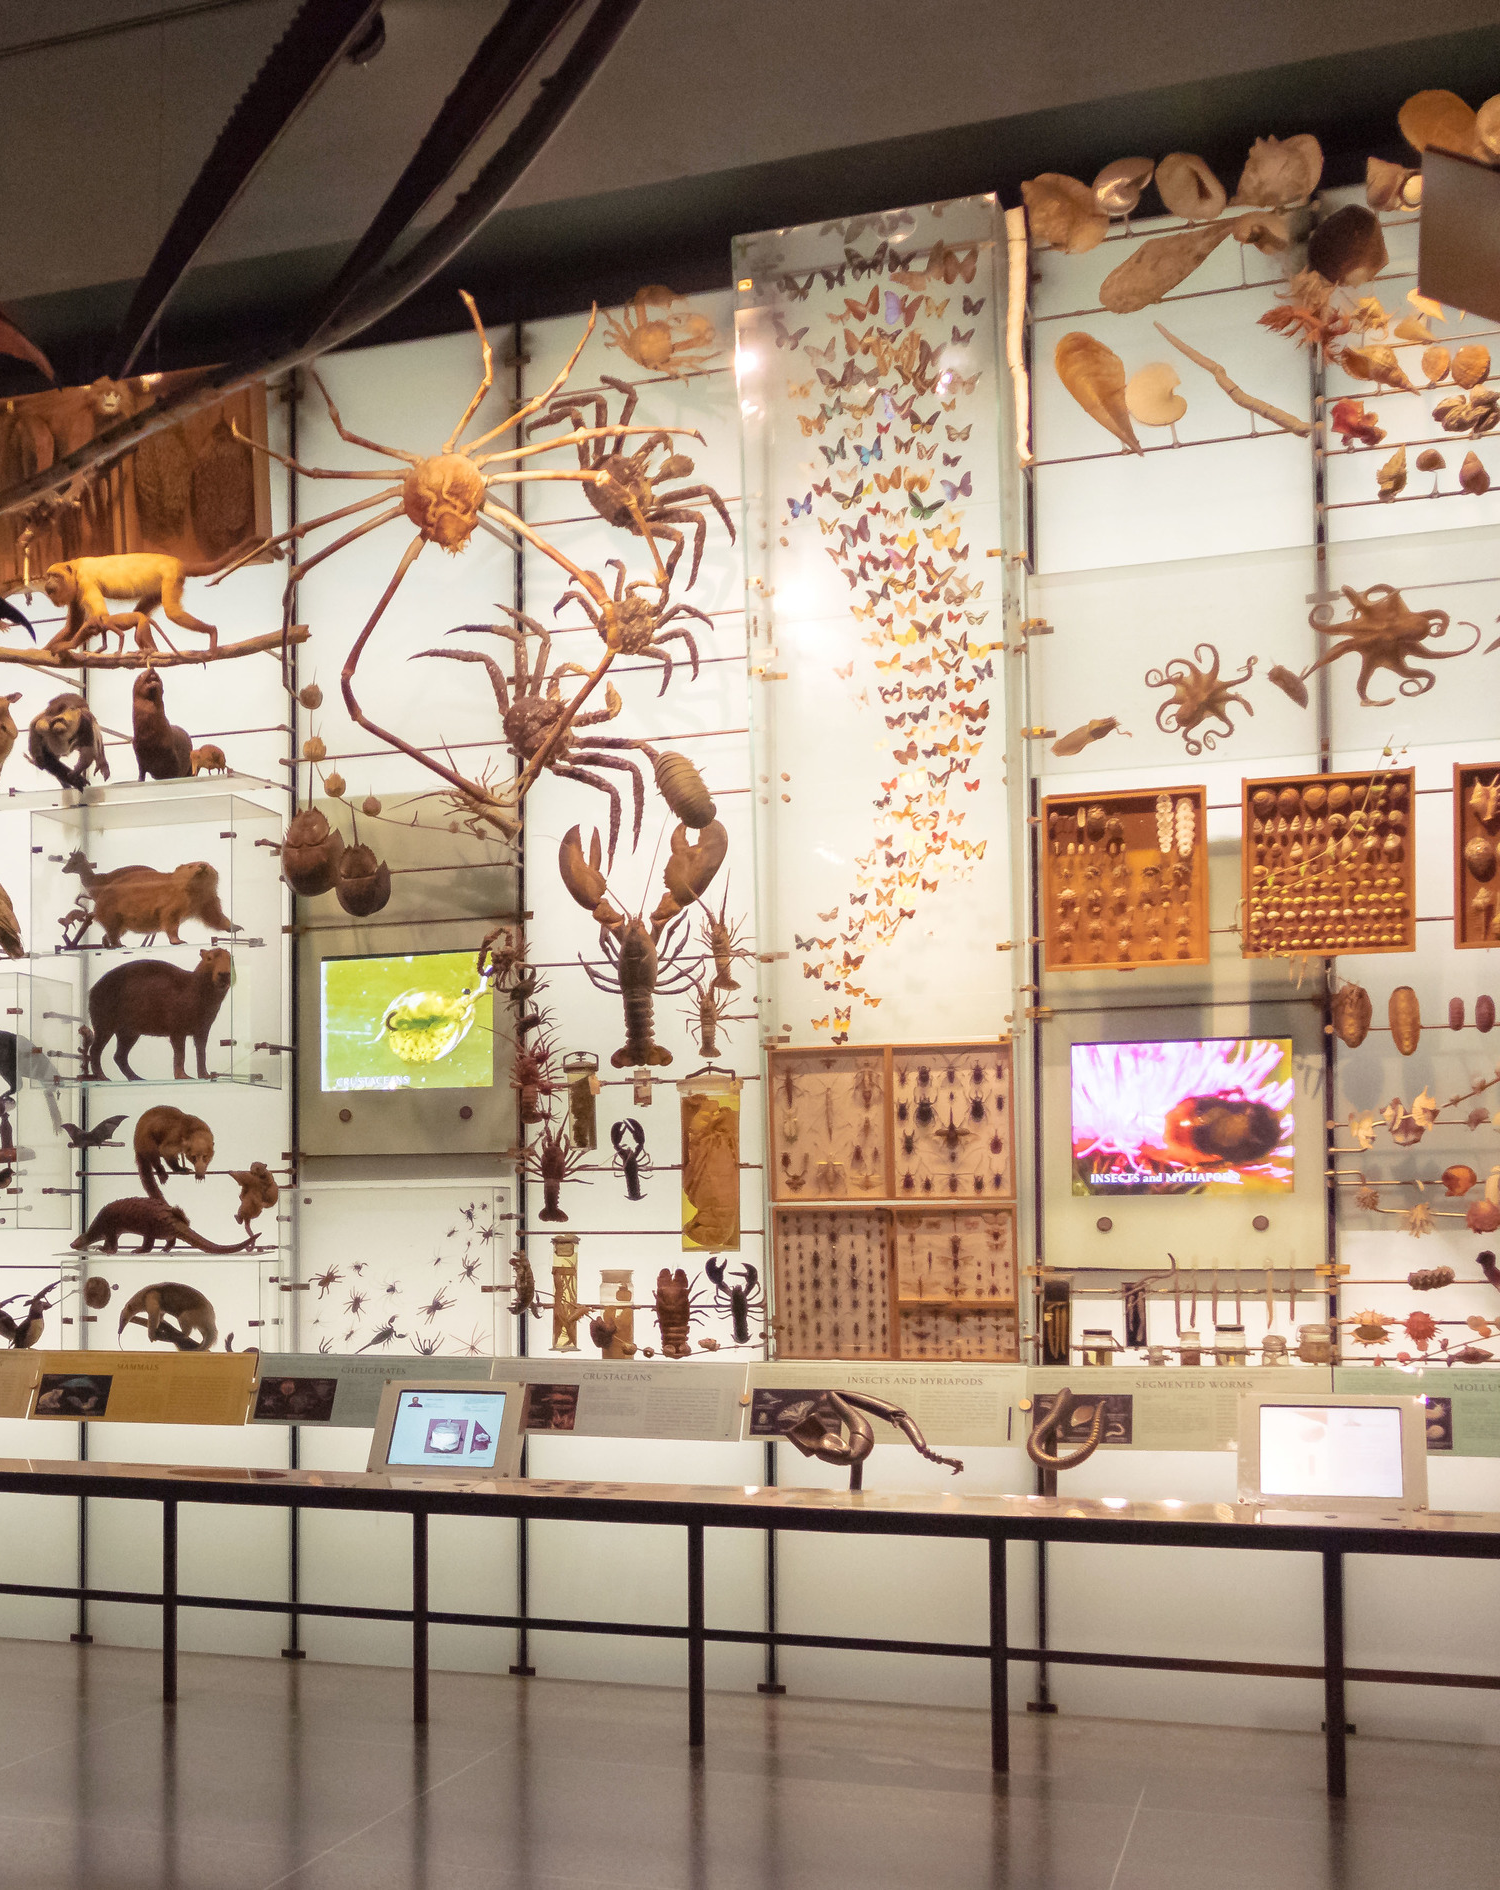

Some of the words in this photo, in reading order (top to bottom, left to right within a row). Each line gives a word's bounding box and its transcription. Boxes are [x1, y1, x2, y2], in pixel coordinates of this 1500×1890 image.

[336, 1075, 411, 1087] CRUSTACEANS
[1090, 1172, 1140, 1184] INSECTS
[1142, 1172, 1163, 1184] and
[1165, 1171, 1241, 1184] MYRIAPODS
[116, 1363, 160, 1371] MAMMALS
[340, 1366, 407, 1375] CHELICERATES
[582, 1372, 652, 1381] CRUSTACEANS
[847, 1376, 890, 1385] INSECTS
[893, 1377, 917, 1385] AND
[920, 1377, 984, 1386] MYRIAPODS
[1135, 1380, 1206, 1389] SEGMENTED
[1209, 1380, 1254, 1389] WORMS
